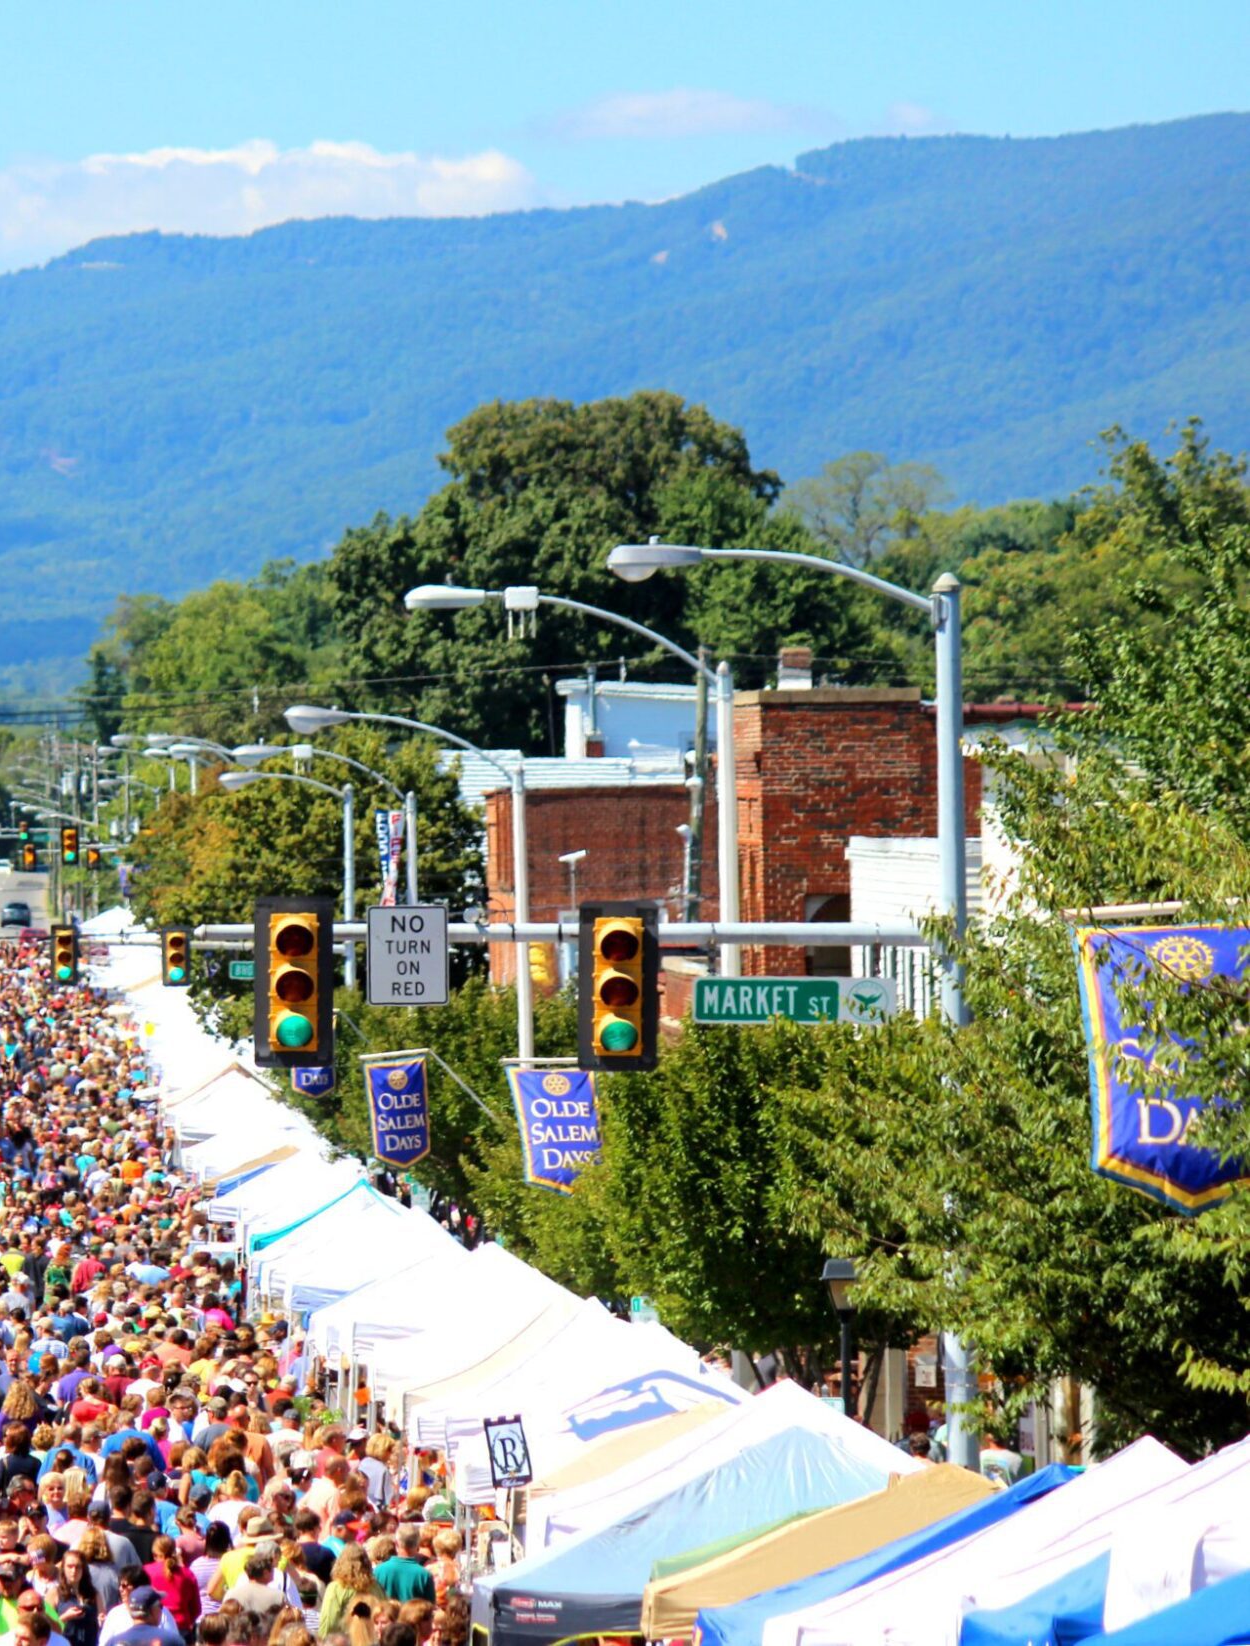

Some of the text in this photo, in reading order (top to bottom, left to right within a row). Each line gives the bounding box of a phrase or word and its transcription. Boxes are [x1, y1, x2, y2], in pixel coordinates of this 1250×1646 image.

[391, 915, 424, 934] NO
[385, 940, 431, 955] TURN
[396, 960, 420, 976] ON
[391, 981, 425, 996] RED
[703, 985, 799, 1016] MARKET
[378, 1092, 421, 1111] OLDE
[531, 1098, 590, 1119] OLDE
[377, 1113, 426, 1132] SALEM
[385, 1134, 422, 1152] DAYS
[531, 1122, 598, 1146] SALEM
[542, 1148, 593, 1170] DAYS
[498, 1437, 522, 1469] R
[537, 1600, 562, 1611] MAX
